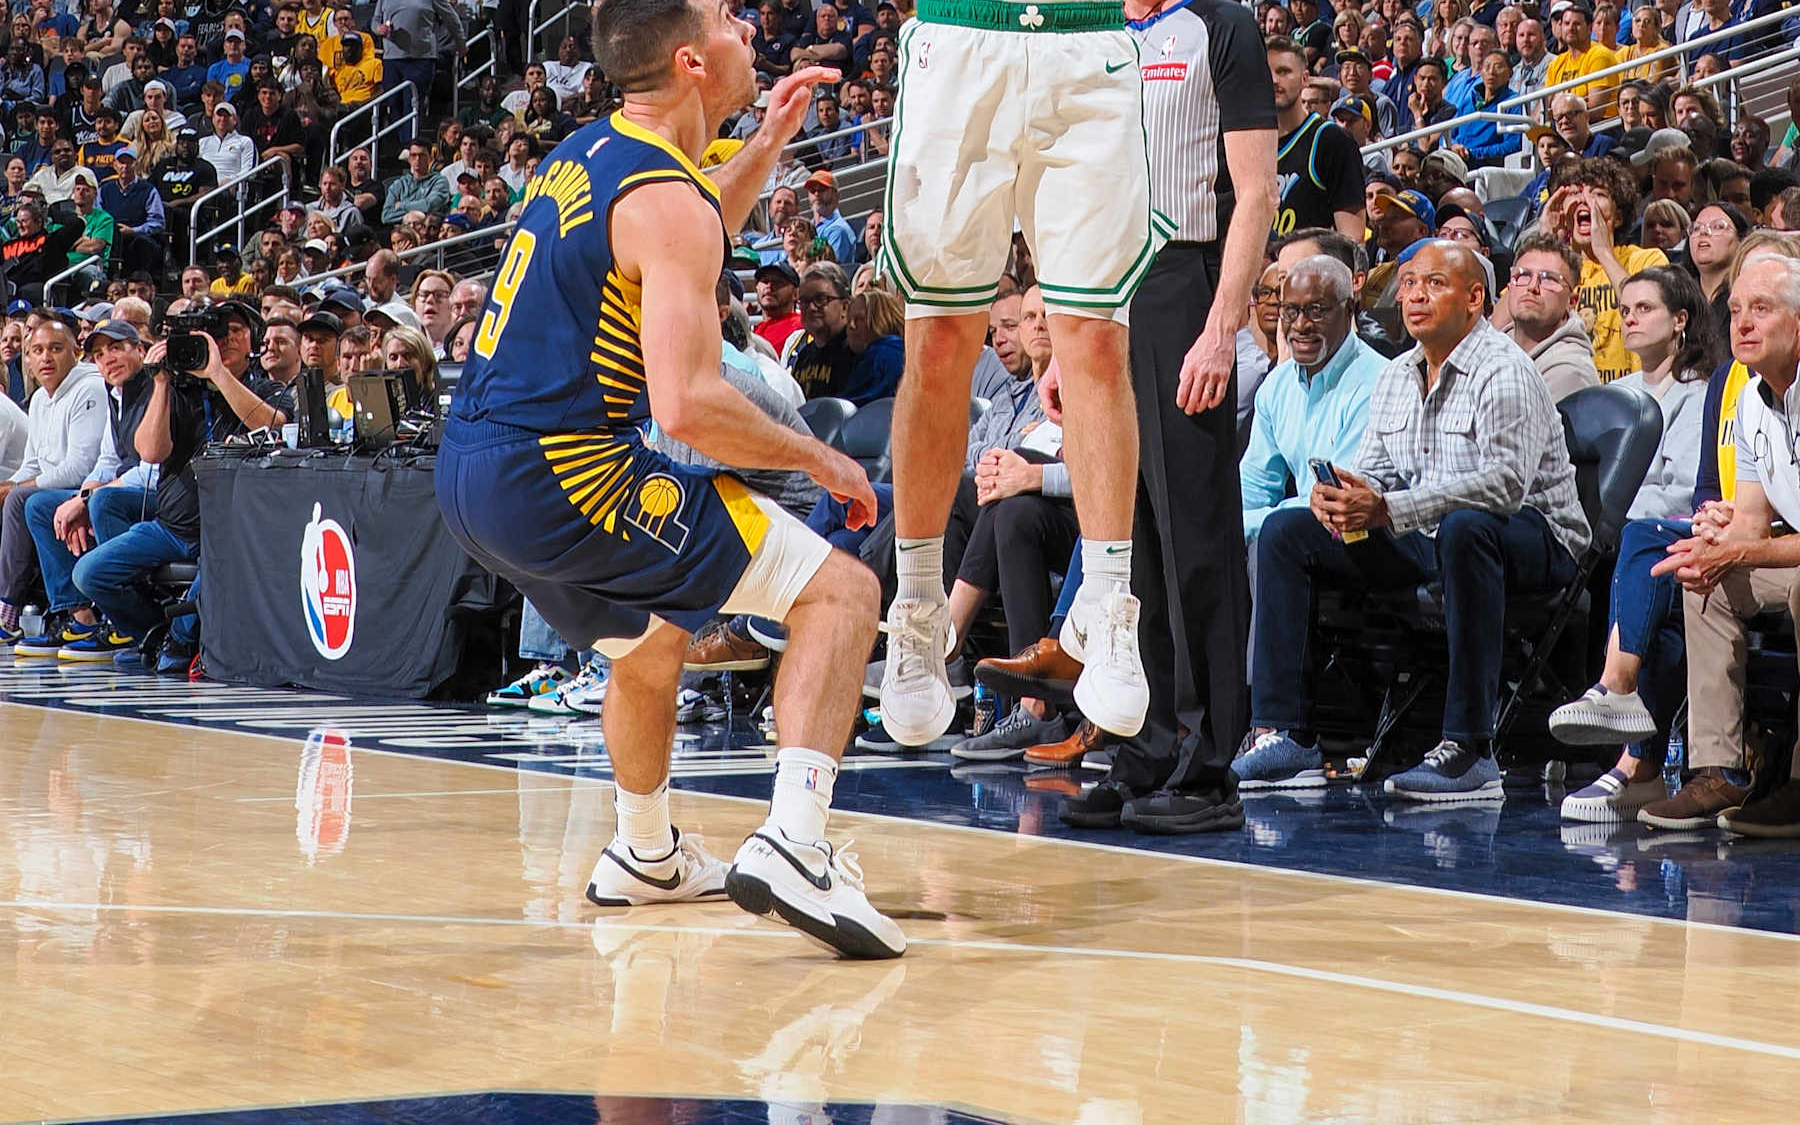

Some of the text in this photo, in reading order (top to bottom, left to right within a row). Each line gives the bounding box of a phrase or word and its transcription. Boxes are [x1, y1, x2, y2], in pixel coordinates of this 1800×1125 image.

[1142, 67, 1186, 79] Emirates
[475, 228, 537, 360] 9
[335, 569, 349, 594] NBA
[323, 596, 350, 617] ESPN
